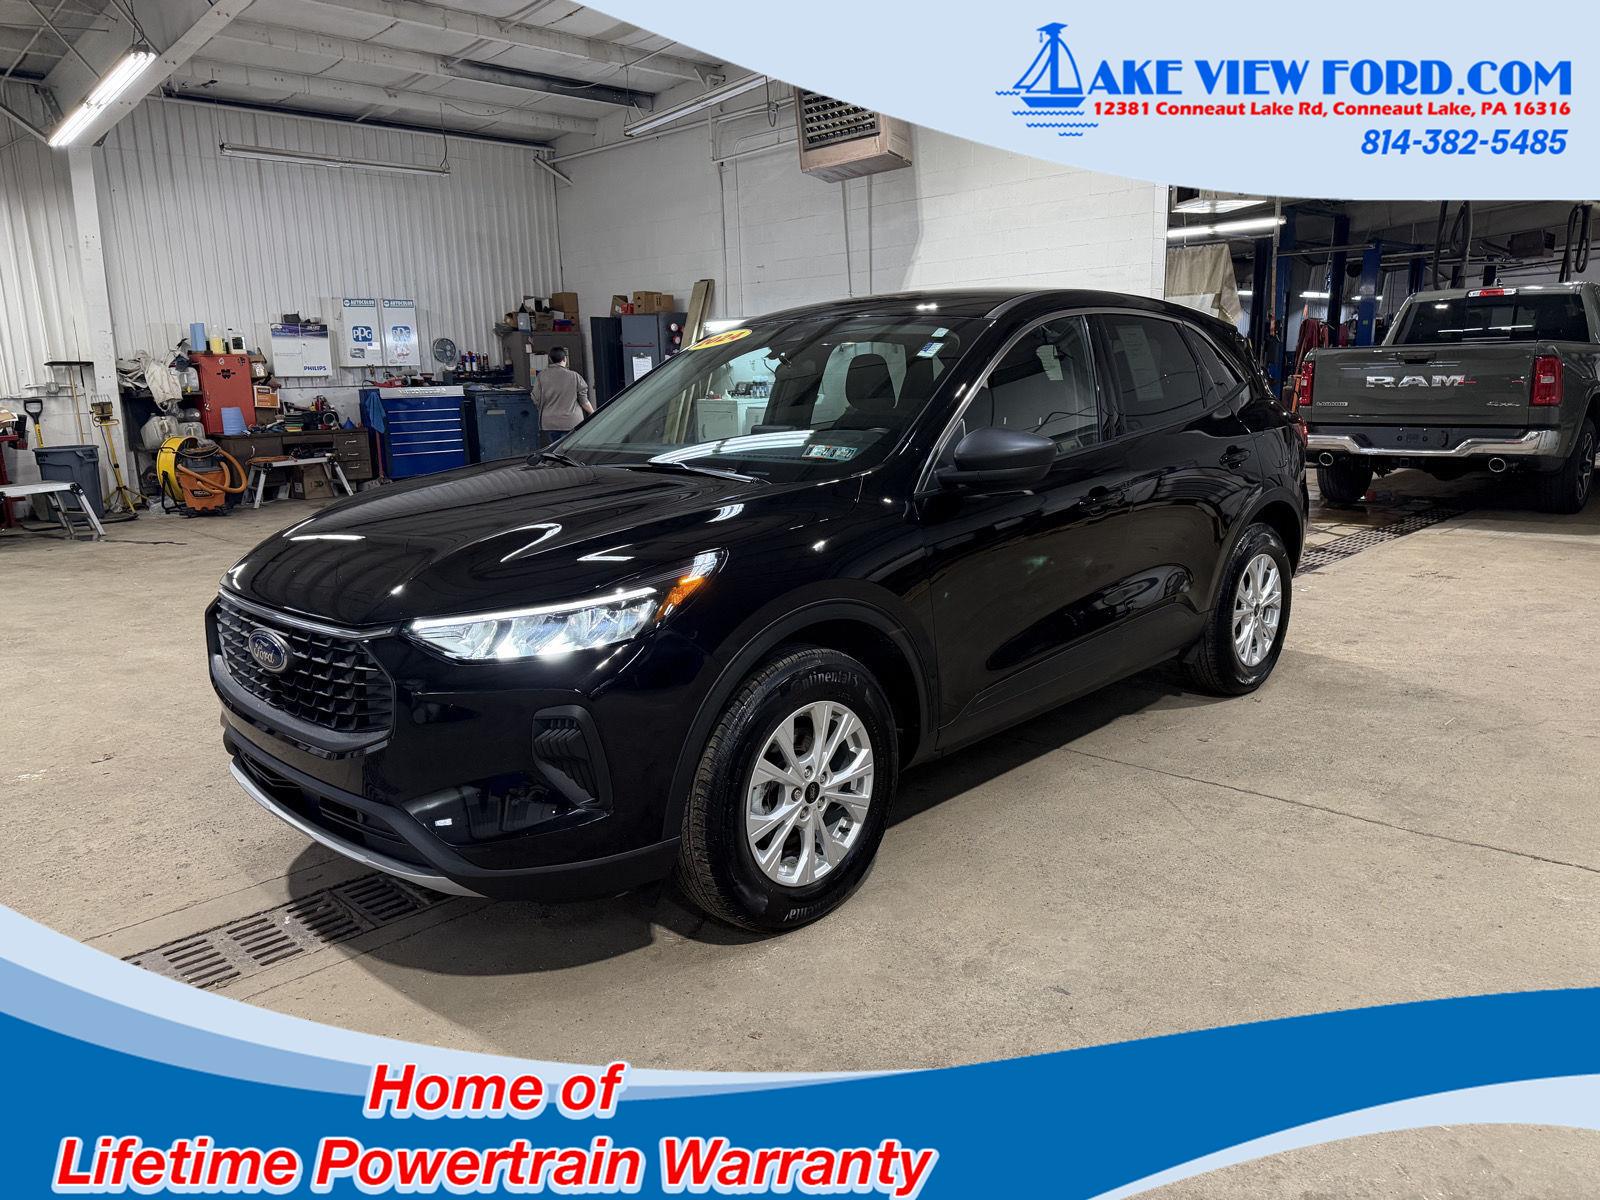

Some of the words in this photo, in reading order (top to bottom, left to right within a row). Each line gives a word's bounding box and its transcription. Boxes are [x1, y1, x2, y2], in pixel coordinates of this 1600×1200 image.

[353, 326, 372, 341] PPG
[1366, 374, 1466, 388] RAM
[253, 638, 276, 664] Ford
